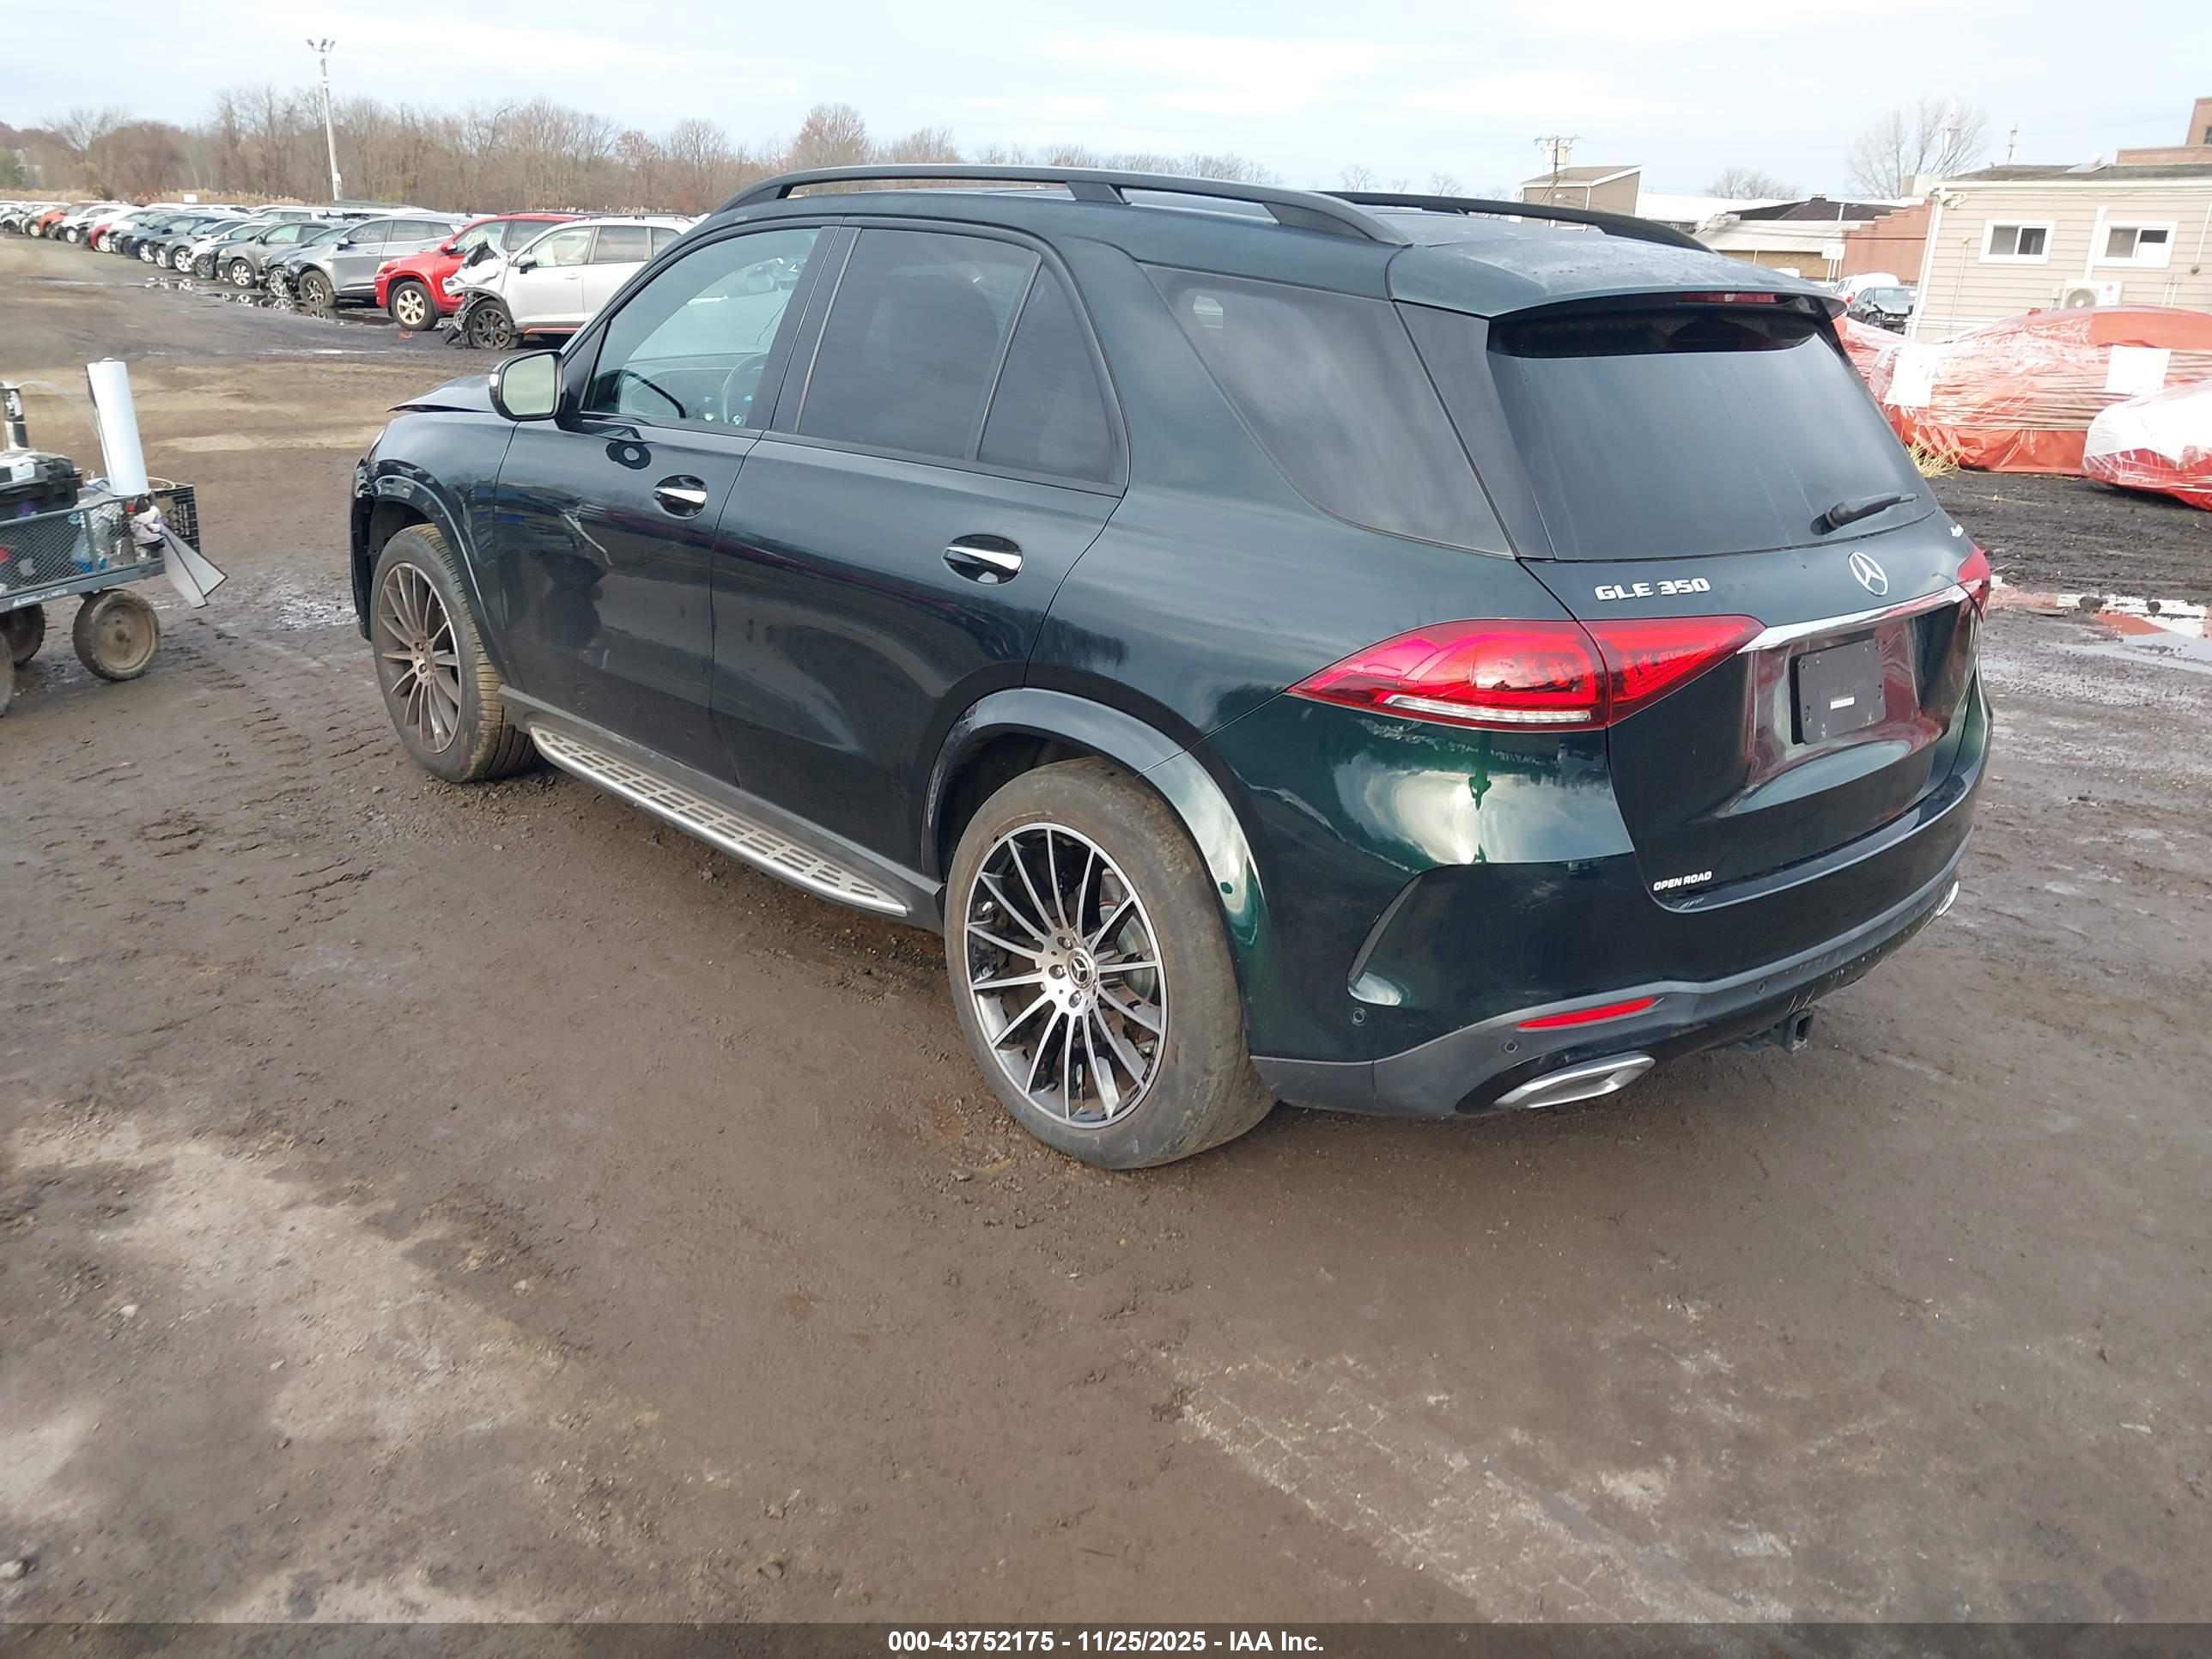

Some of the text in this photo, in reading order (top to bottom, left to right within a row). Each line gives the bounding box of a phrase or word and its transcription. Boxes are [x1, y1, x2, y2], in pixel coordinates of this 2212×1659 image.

[1594, 577, 1711, 601] GLE 350
[1653, 871, 1712, 891] OPEN ROAD
